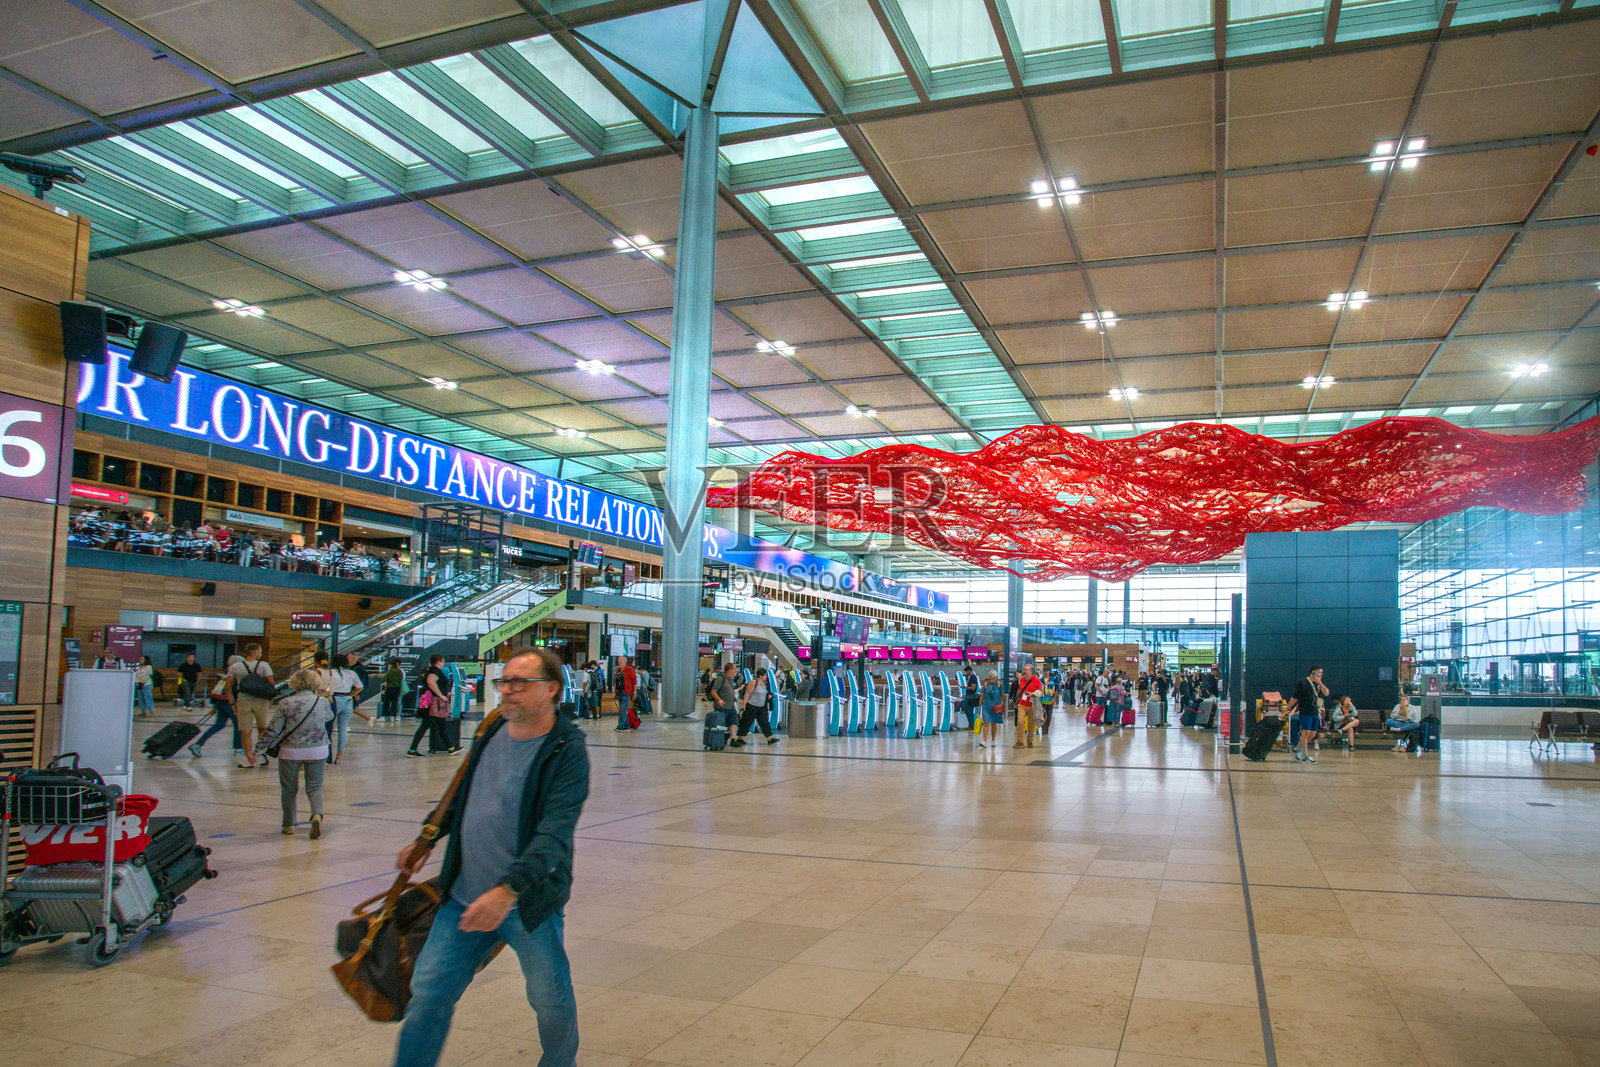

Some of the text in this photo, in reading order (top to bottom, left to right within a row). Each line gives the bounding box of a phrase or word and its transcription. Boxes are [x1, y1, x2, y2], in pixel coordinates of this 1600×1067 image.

[0, 410, 47, 477] 6
[171, 369, 536, 514] LONG-DISTANCE
[499, 622, 521, 638] Prepare
[520, 618, 529, 626] for
[529, 605, 550, 620] Security
